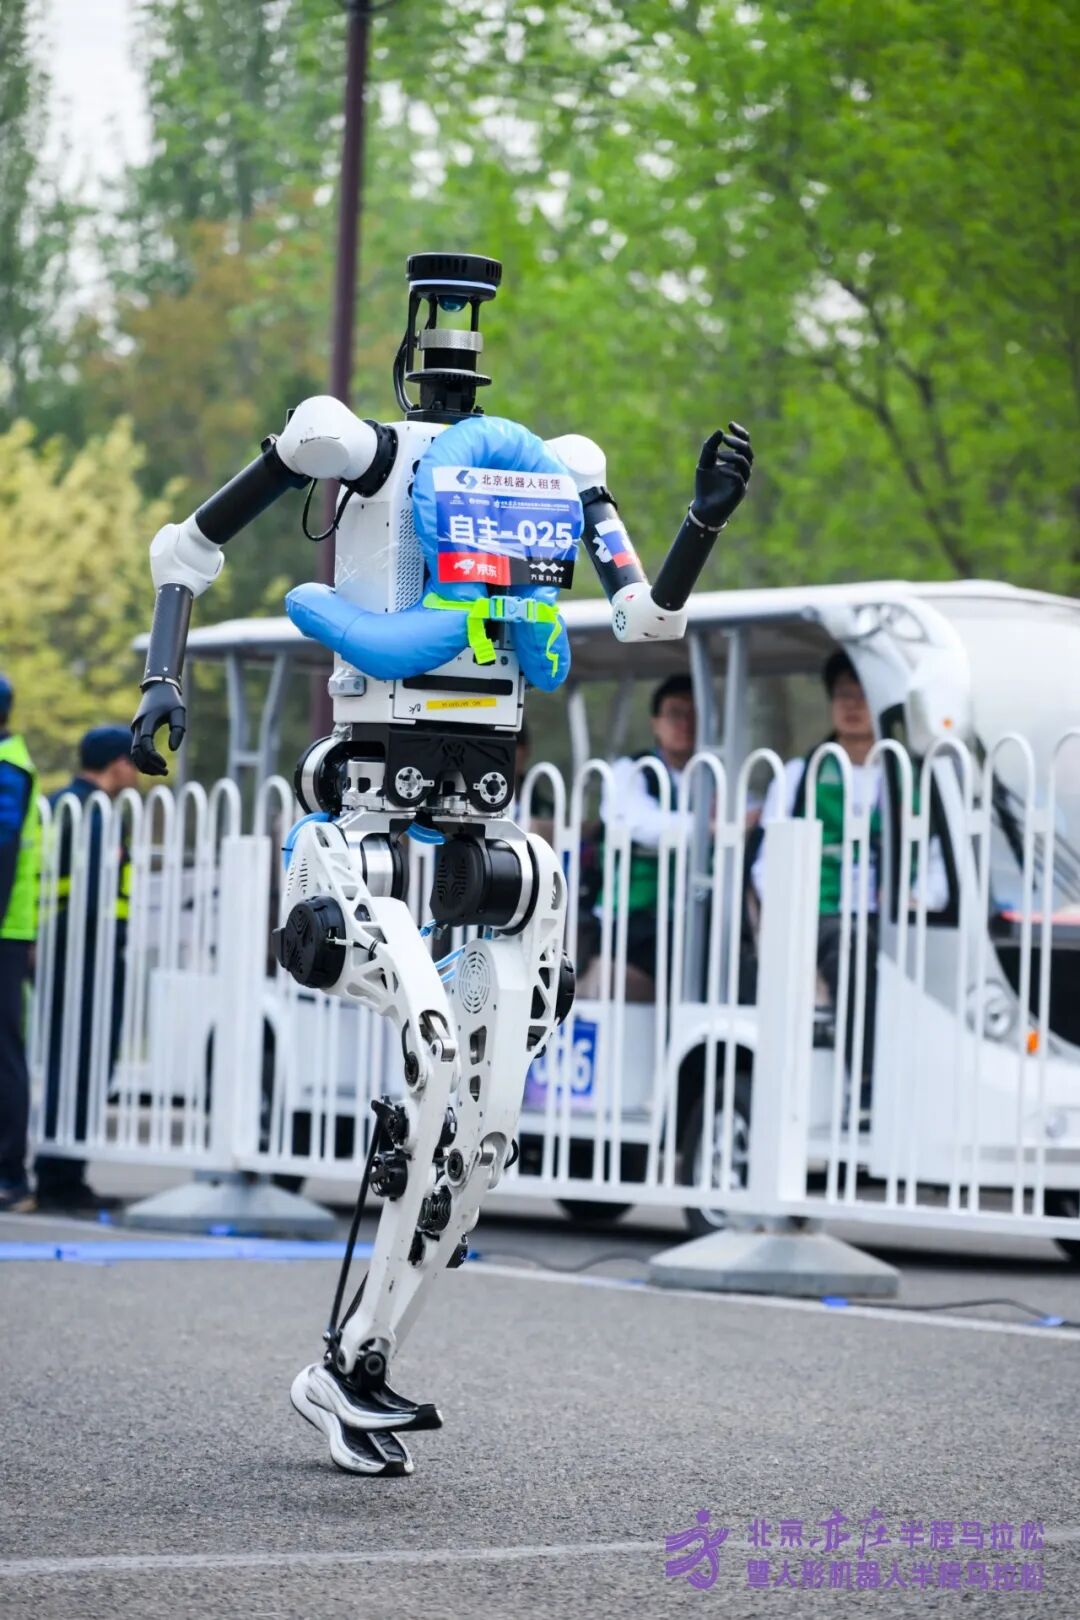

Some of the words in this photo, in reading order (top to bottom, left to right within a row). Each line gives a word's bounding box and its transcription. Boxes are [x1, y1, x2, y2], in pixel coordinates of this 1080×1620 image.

[482, 474, 561, 490] 北京机器人租赁
